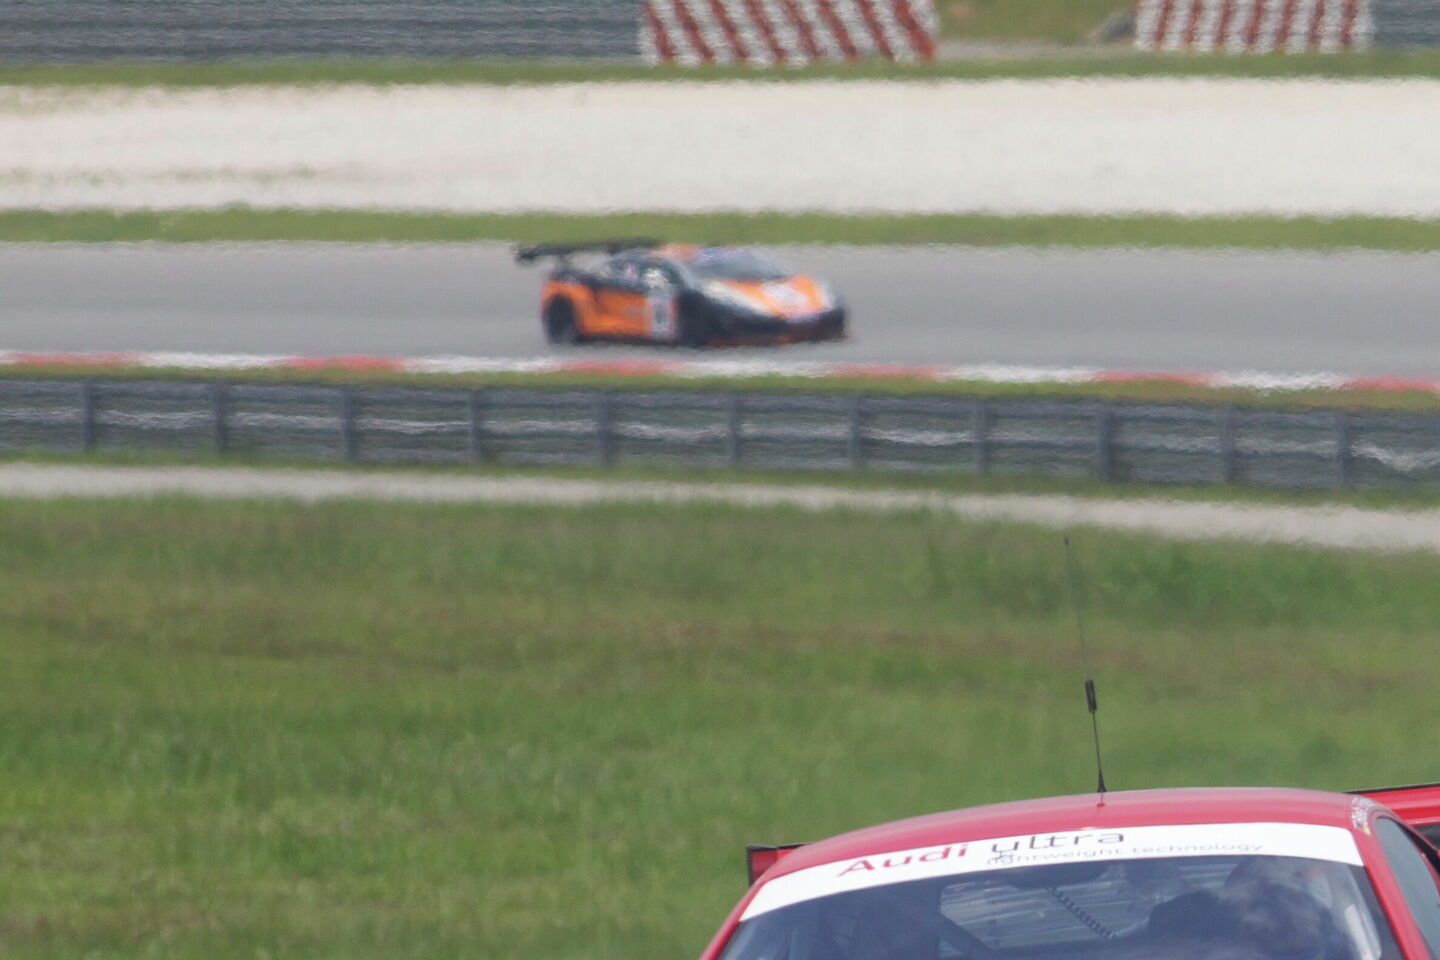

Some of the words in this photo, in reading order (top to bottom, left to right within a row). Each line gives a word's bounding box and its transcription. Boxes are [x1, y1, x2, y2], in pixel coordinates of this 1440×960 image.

[837, 843, 969, 877] Audi
[991, 831, 1125, 853] ultra
[1132, 842, 1264, 855] technology
